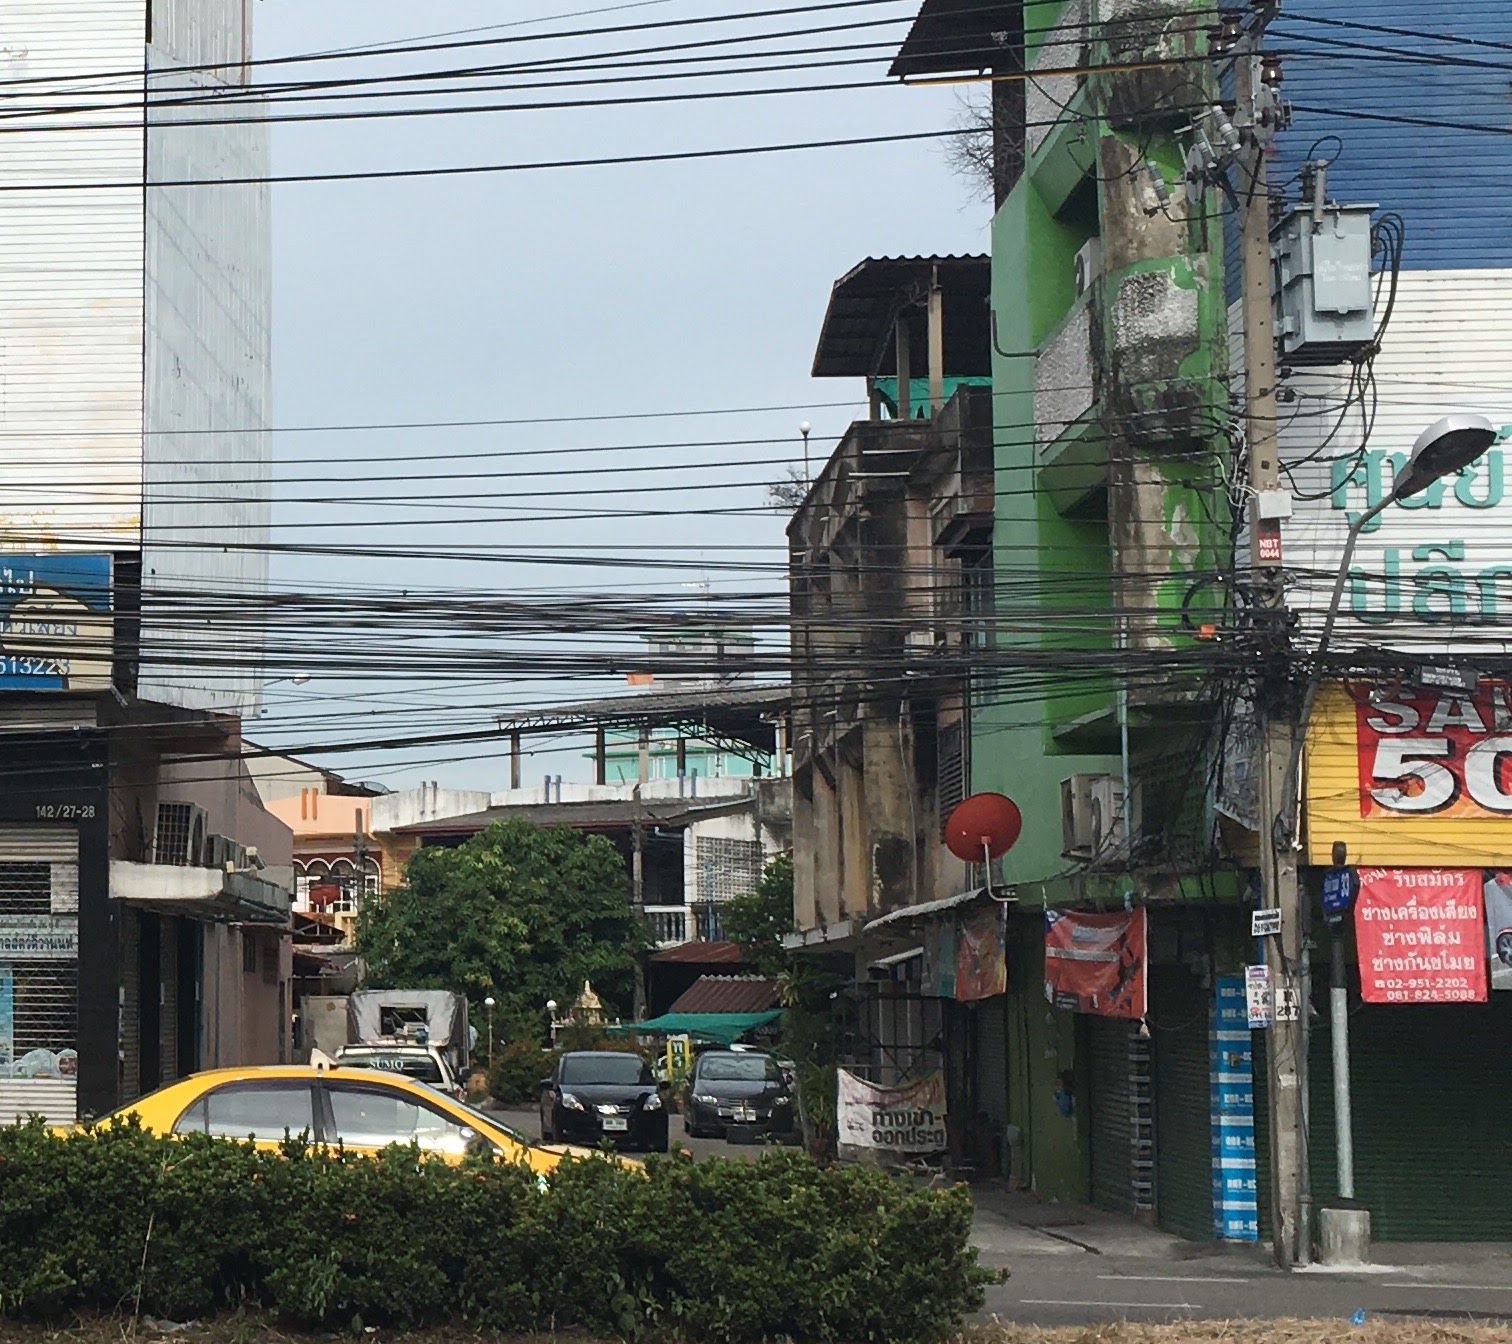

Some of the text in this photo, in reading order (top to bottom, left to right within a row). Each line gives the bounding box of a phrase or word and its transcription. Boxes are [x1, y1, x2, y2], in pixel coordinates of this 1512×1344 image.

[1259, 538, 1279, 548] NBT
[35, 805, 96, 820] 142/27-28
[1362, 895, 1477, 921] ช่างเครื่องเสียง
[1382, 924, 1461, 946] ช่างฟิล์ม
[1372, 950, 1475, 971] ช่างกันขโมย
[1387, 977, 1468, 988] 02-951-2202
